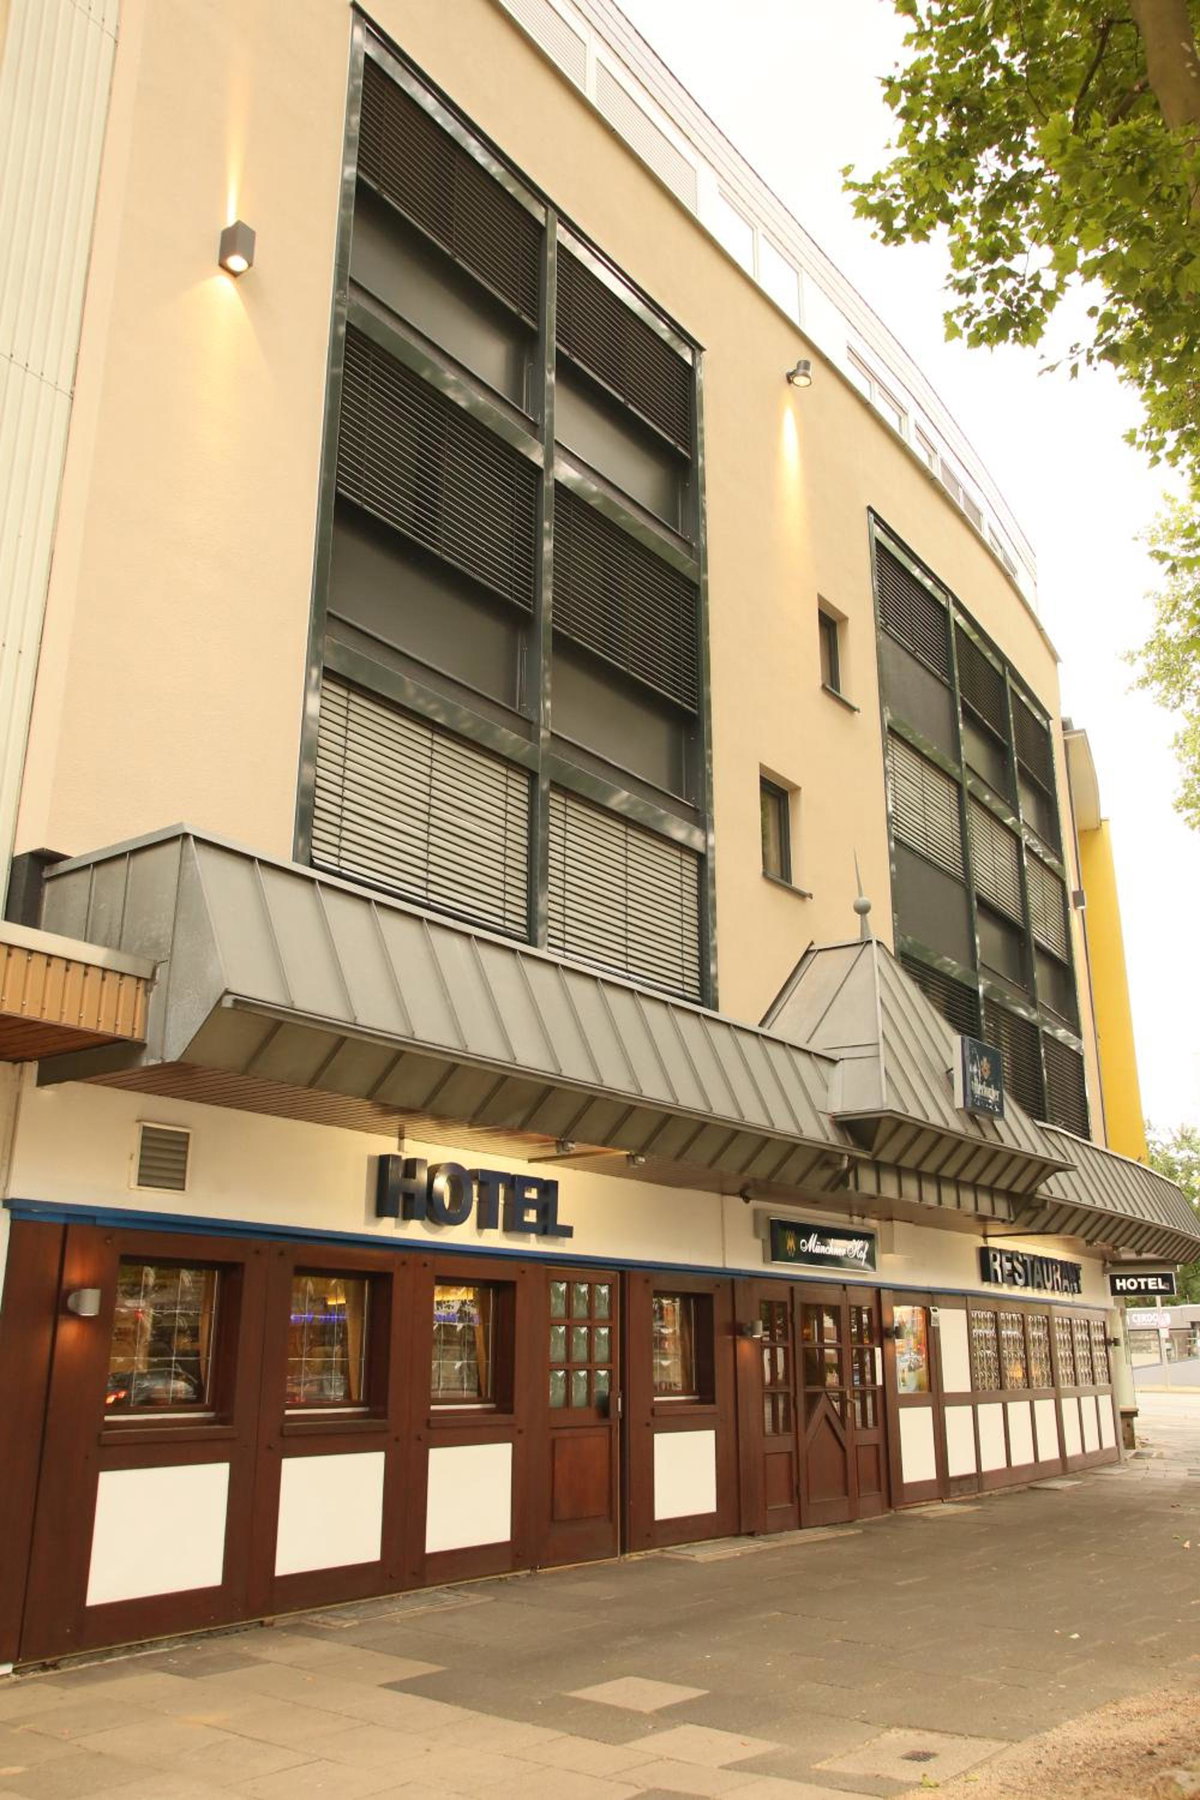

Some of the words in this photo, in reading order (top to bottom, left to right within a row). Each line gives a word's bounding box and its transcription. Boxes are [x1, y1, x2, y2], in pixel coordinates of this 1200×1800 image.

[376, 1154, 573, 1238] HOTEL
[847, 1239, 869, 1266] Hof
[980, 1247, 1082, 1294] RESTAURANT
[1115, 1277, 1168, 1291] HOTEL
